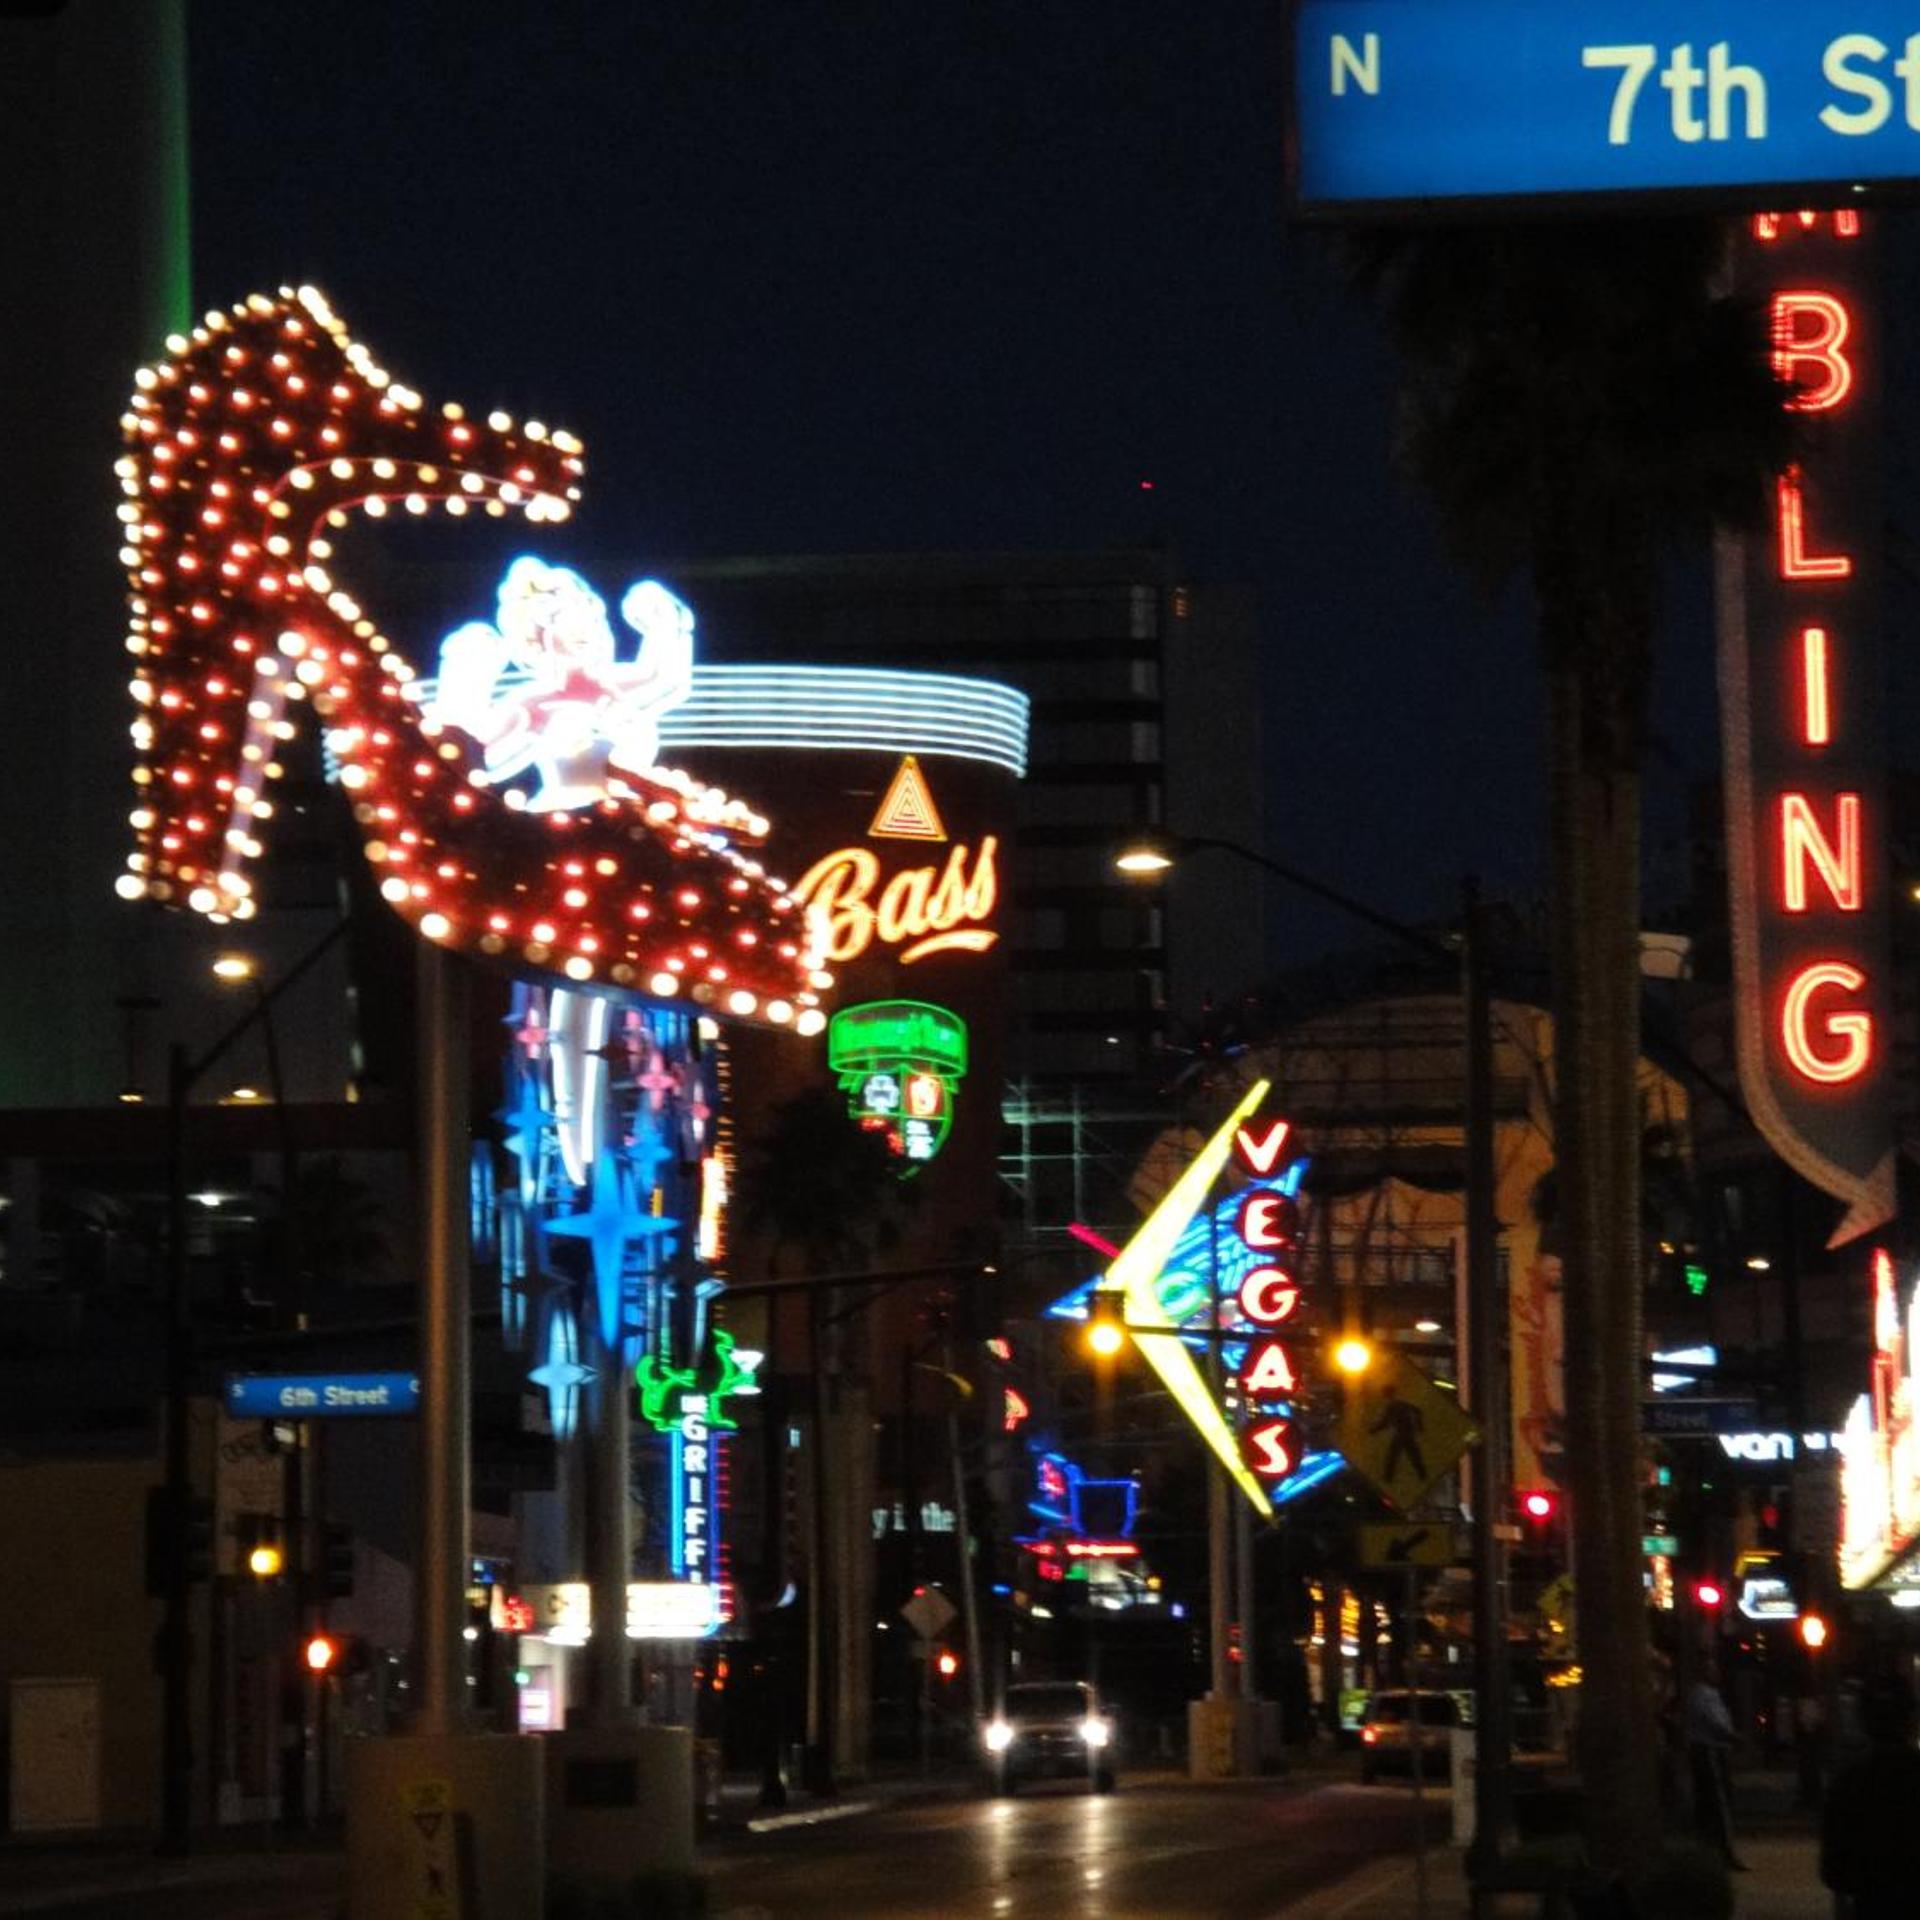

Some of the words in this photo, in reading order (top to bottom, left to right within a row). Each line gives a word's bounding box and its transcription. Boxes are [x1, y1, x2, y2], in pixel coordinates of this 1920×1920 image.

[1330, 33, 1381, 96] N
[1581, 40, 1768, 146] 7th
[1752, 208, 1873, 1084] BLING
[789, 834, 998, 963] Bass
[1236, 1120, 1301, 1475] VEGAS
[279, 1386, 319, 1407] 6th
[323, 1384, 390, 1406] Street
